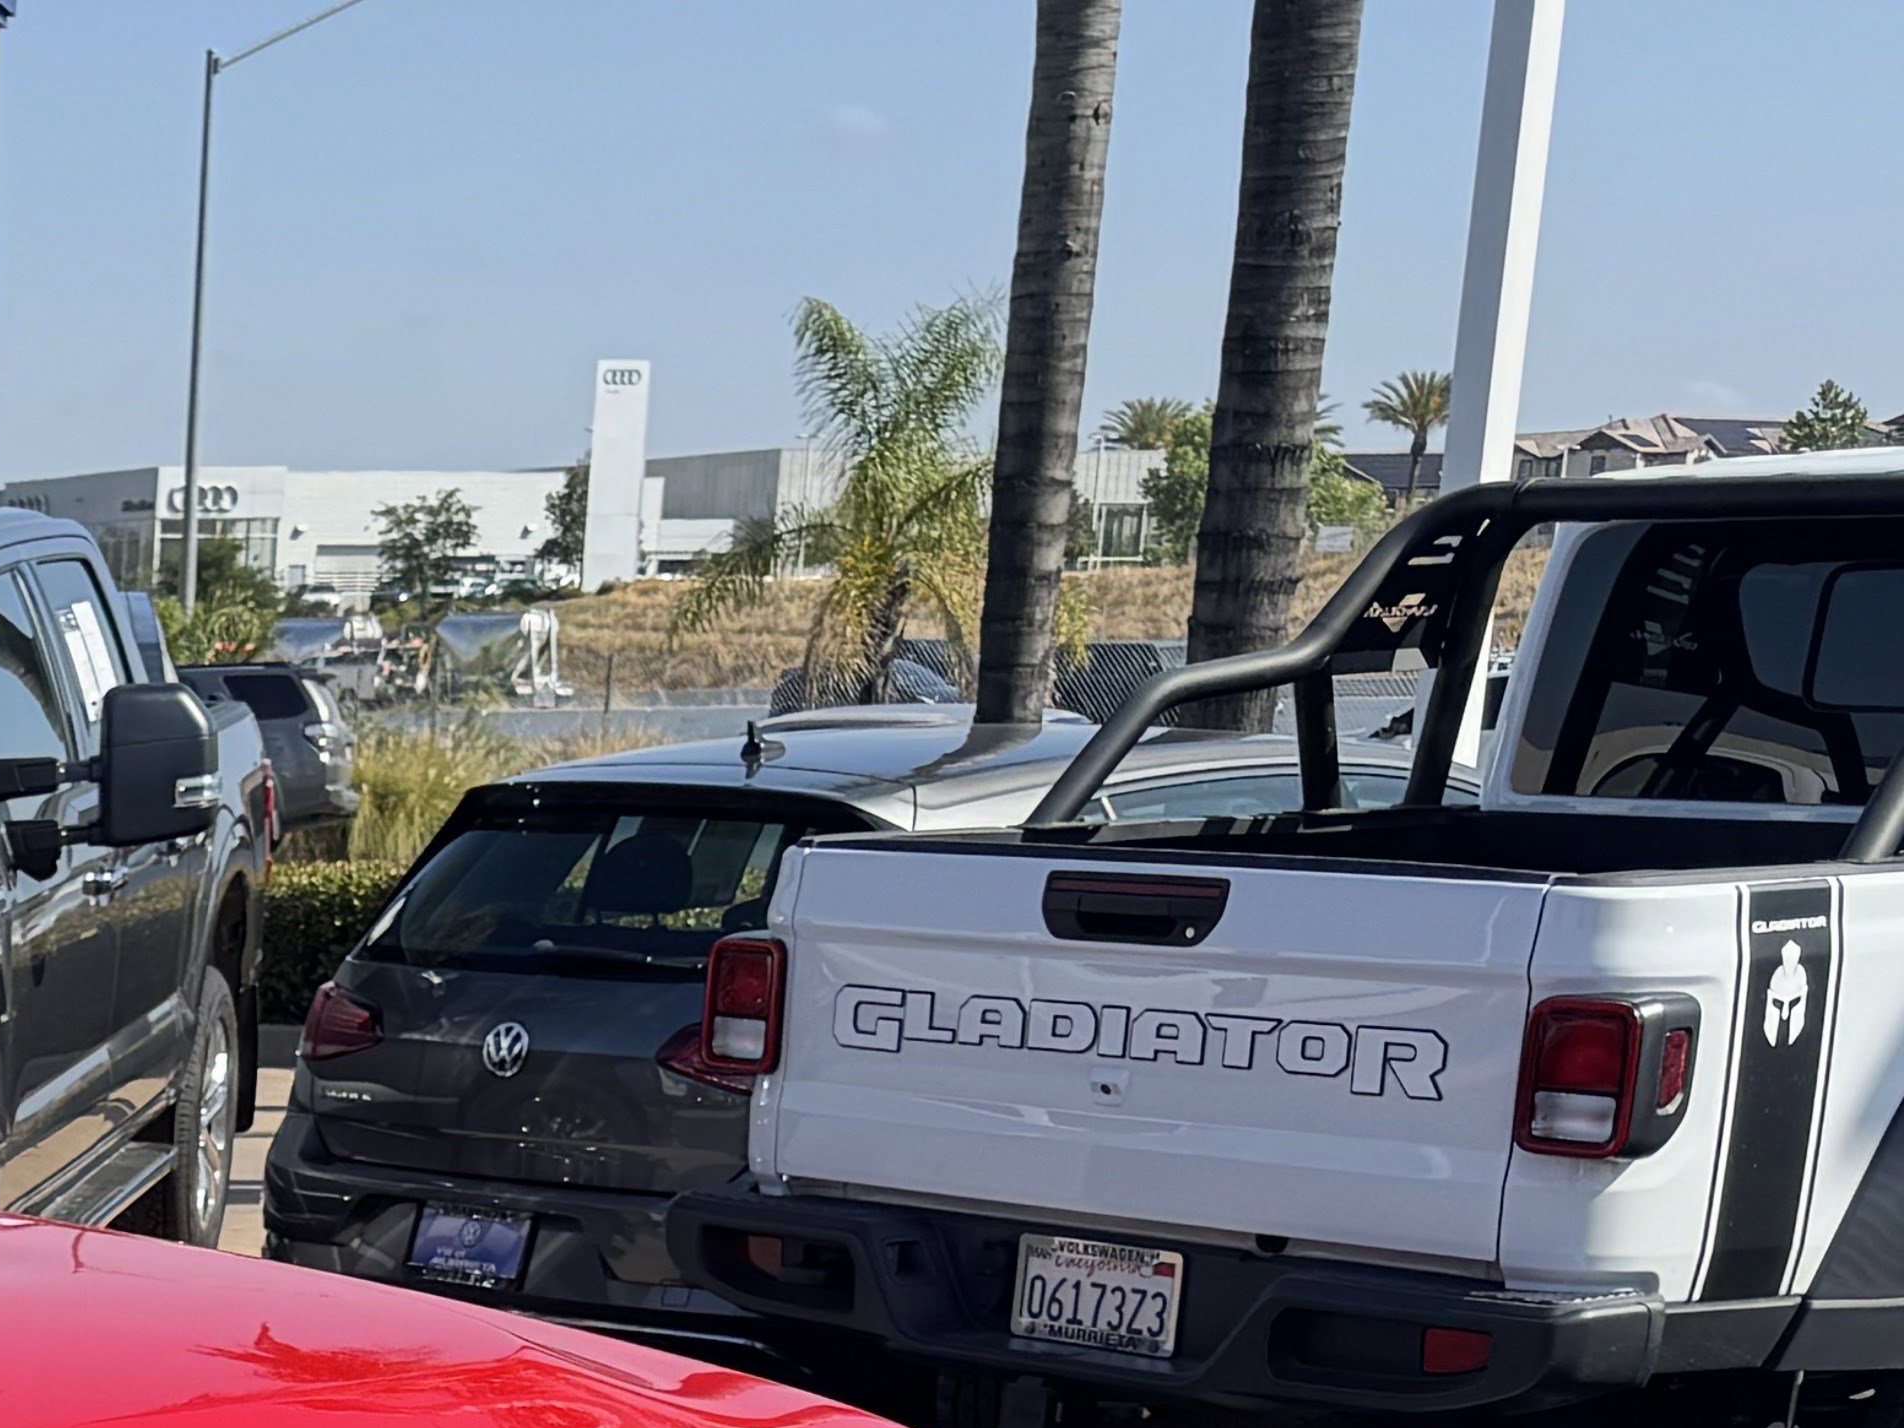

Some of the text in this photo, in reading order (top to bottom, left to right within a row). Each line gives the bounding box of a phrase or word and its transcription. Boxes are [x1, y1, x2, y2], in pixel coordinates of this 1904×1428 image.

[1752, 916, 1827, 934] GLADIATOR
[833, 983, 1449, 1101] GLADIATOR
[1058, 1240, 1144, 1263] VOLKSWAGEN
[1027, 1274, 1168, 1338] 06173Z3
